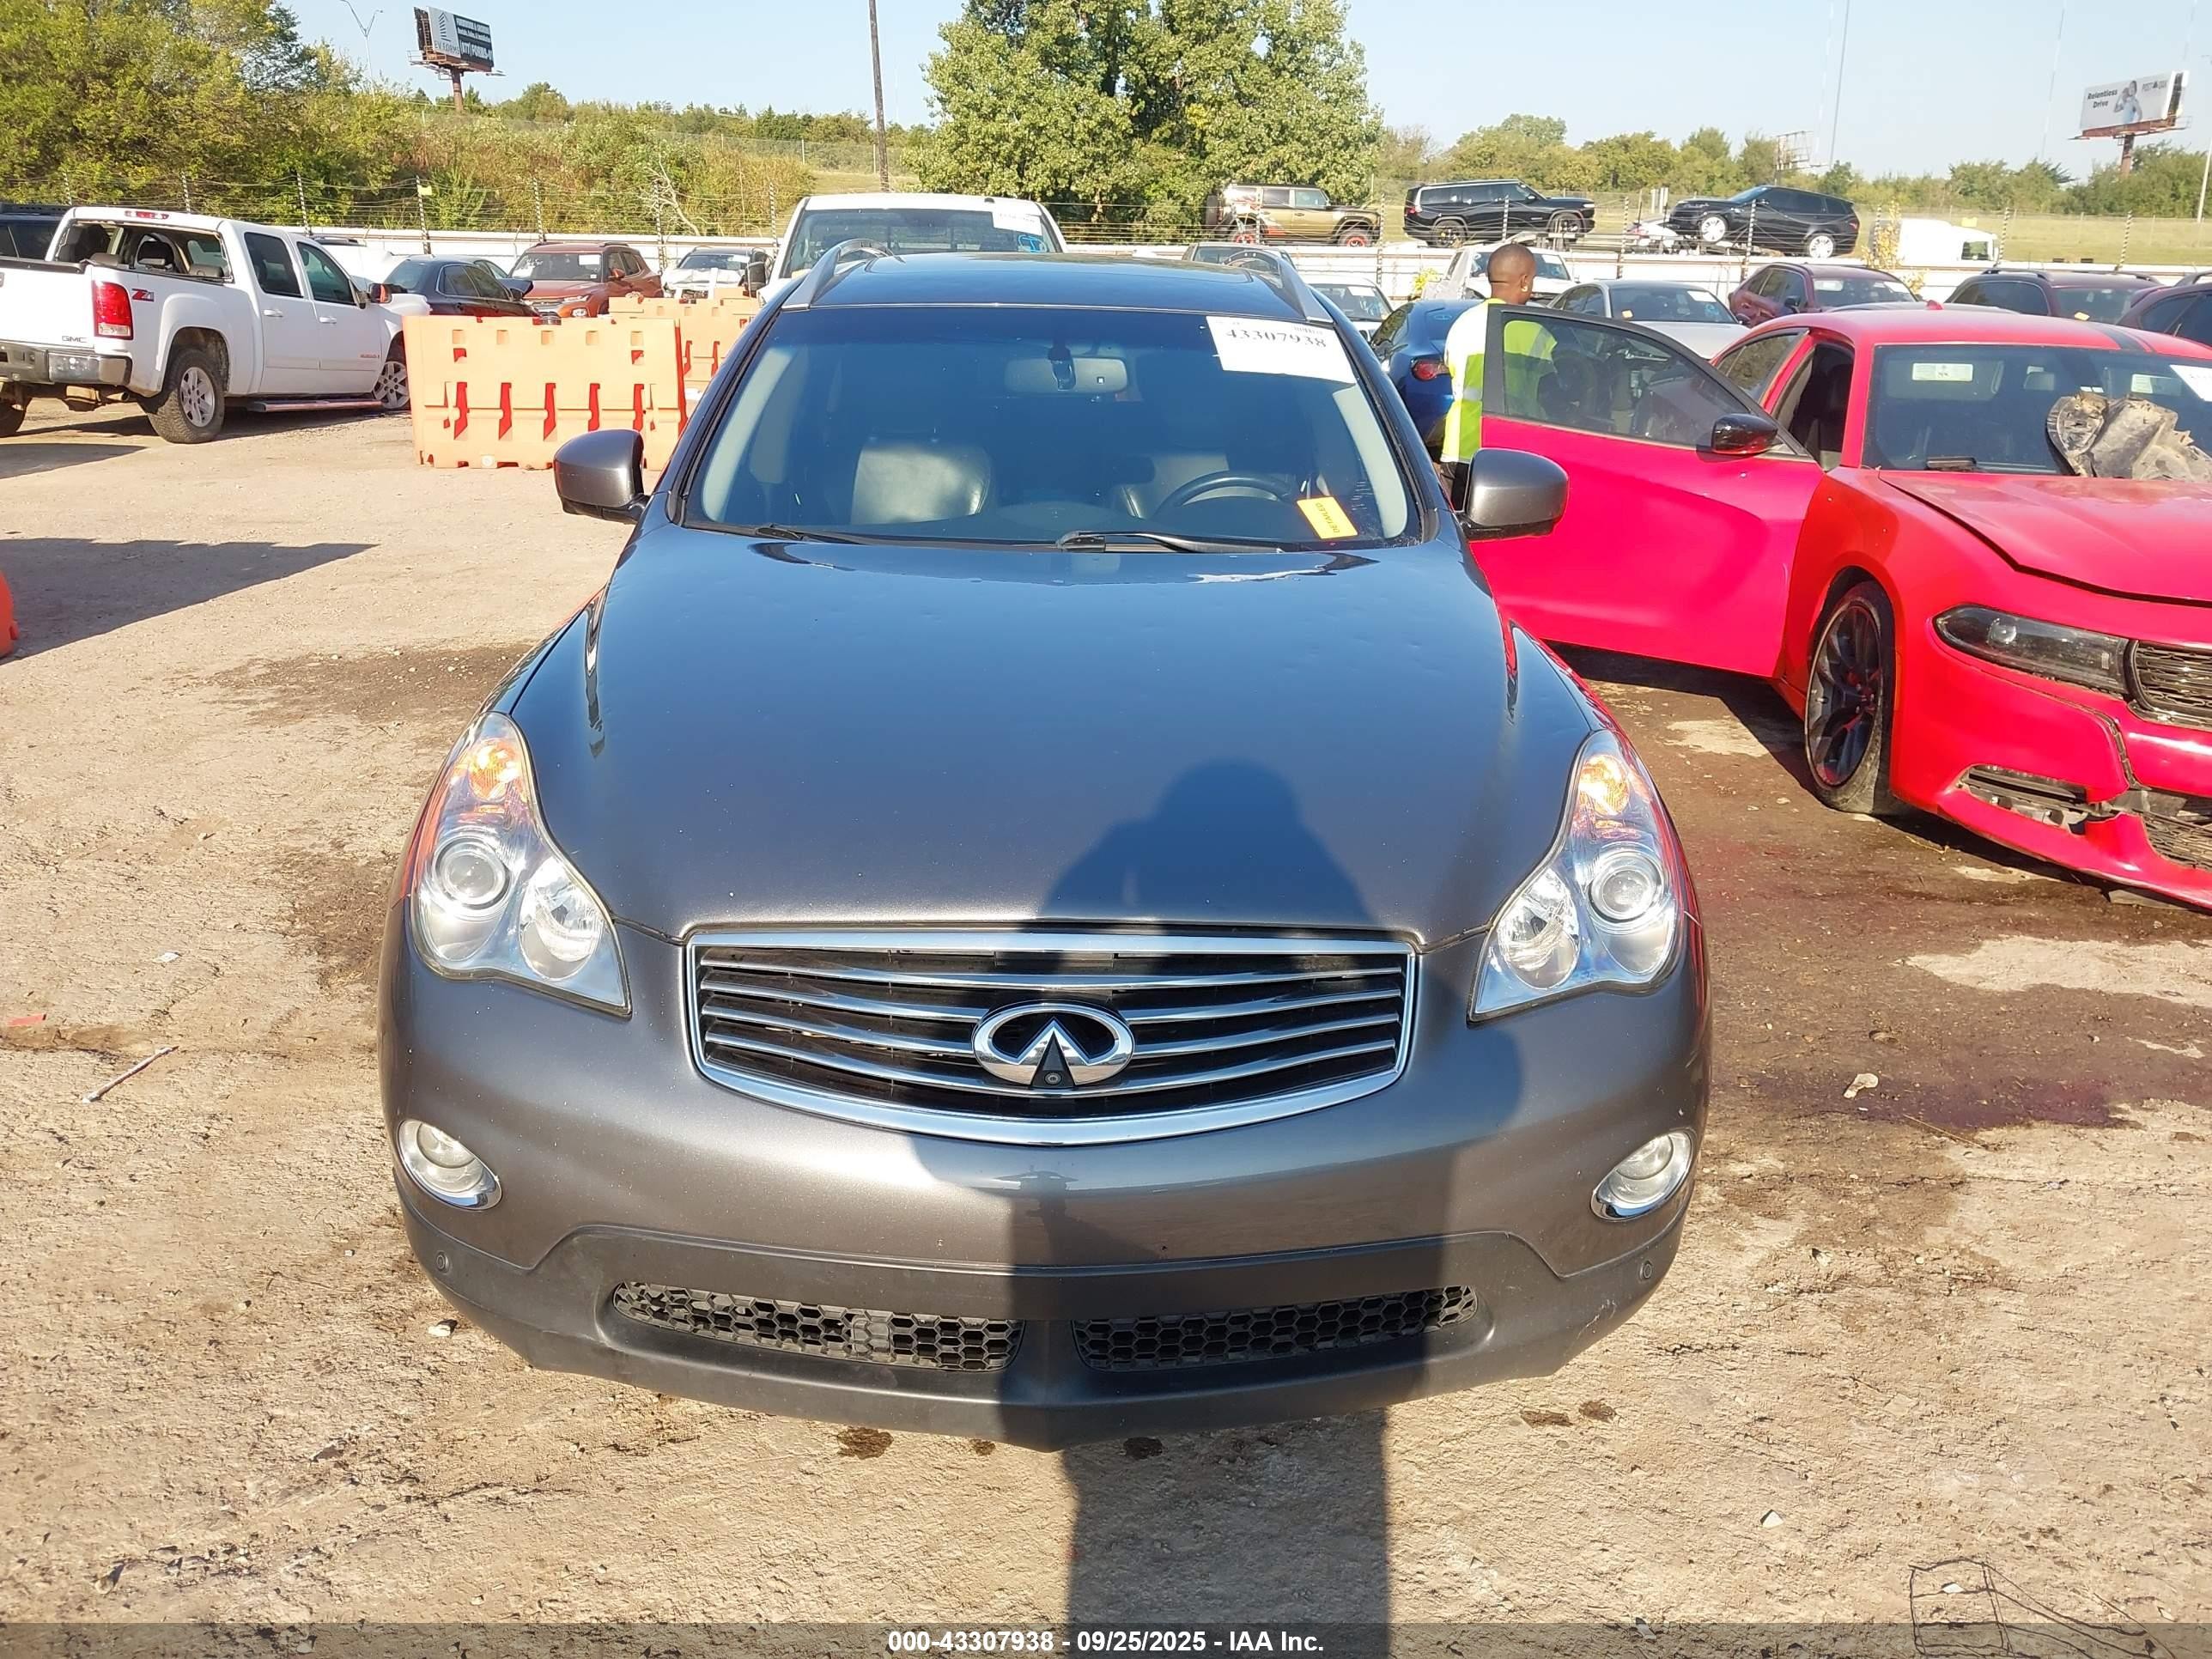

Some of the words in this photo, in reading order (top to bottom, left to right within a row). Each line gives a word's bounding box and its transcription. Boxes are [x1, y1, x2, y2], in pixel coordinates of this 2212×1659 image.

[2087, 89, 2118, 100] Relentless
[1226, 328, 1327, 348] 43307938
[1315, 502, 1340, 533] DETAILED
